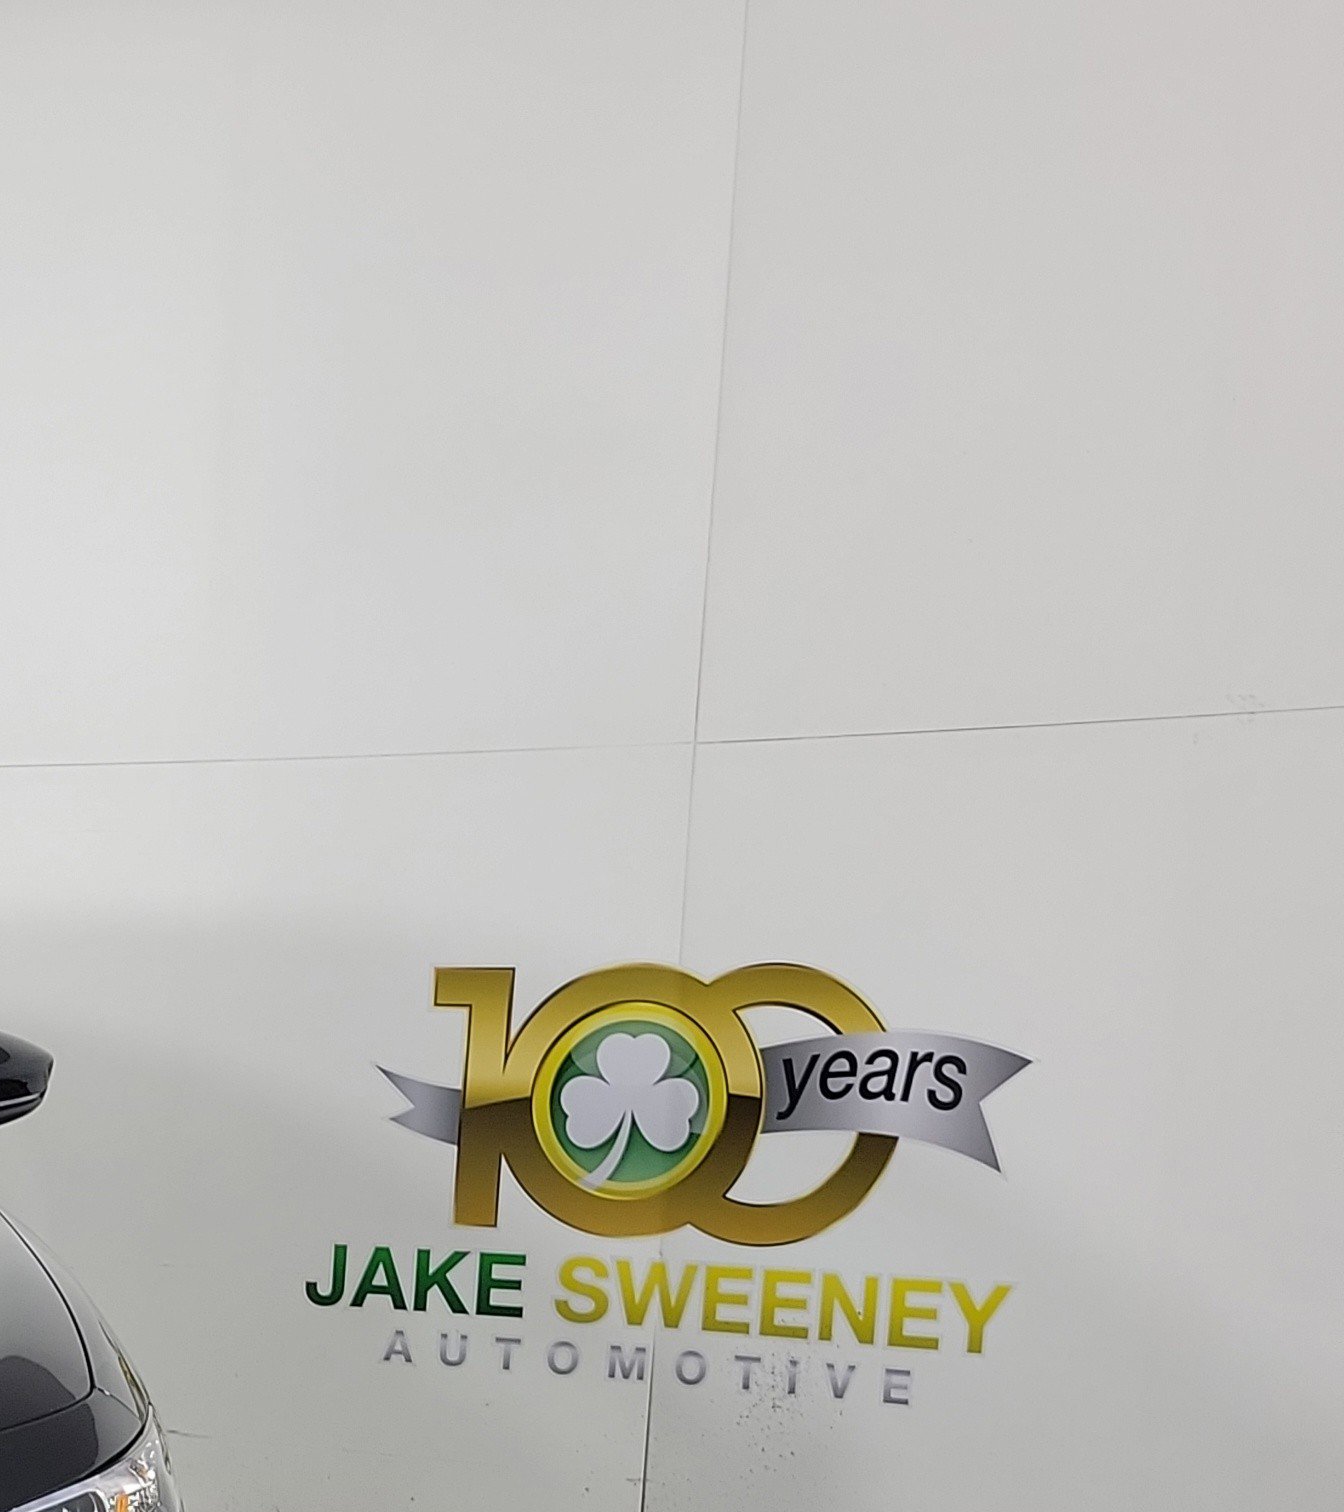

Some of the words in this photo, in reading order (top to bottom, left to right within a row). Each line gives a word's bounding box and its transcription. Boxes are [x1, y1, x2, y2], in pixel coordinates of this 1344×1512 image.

[434, 962, 898, 1246] 100
[776, 1046, 968, 1121] years
[305, 1244, 527, 1318] JAKE
[554, 1256, 1011, 1354] SWEENEY
[383, 1331, 910, 1405] AUTOMOTIVE
